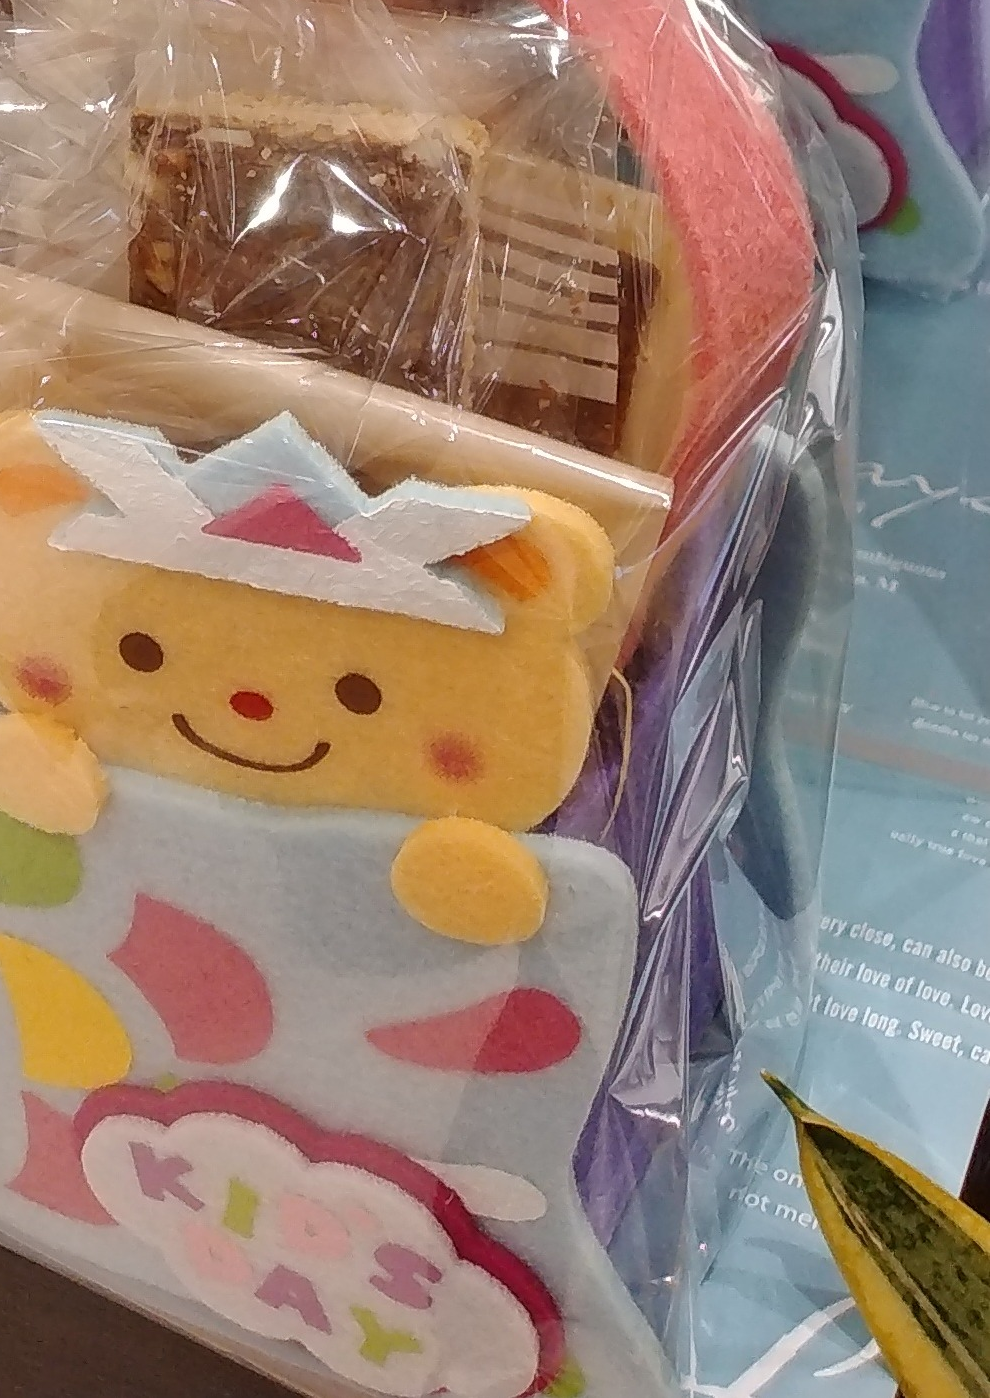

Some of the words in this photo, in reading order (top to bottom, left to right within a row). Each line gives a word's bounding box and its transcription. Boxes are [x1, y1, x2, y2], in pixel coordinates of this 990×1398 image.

[848, 922, 896, 953] close,
[901, 937, 934, 961] can
[935, 944, 972, 974] also
[815, 951, 854, 978] their
[856, 961, 890, 990] love
[894, 974, 916, 995] of
[915, 978, 954, 1008] love.
[823, 995, 859, 1025] love
[907, 1019, 964, 1058] Sweet,
[772, 1167, 803, 1189] on
[181, 1220, 424, 1367] DAY
